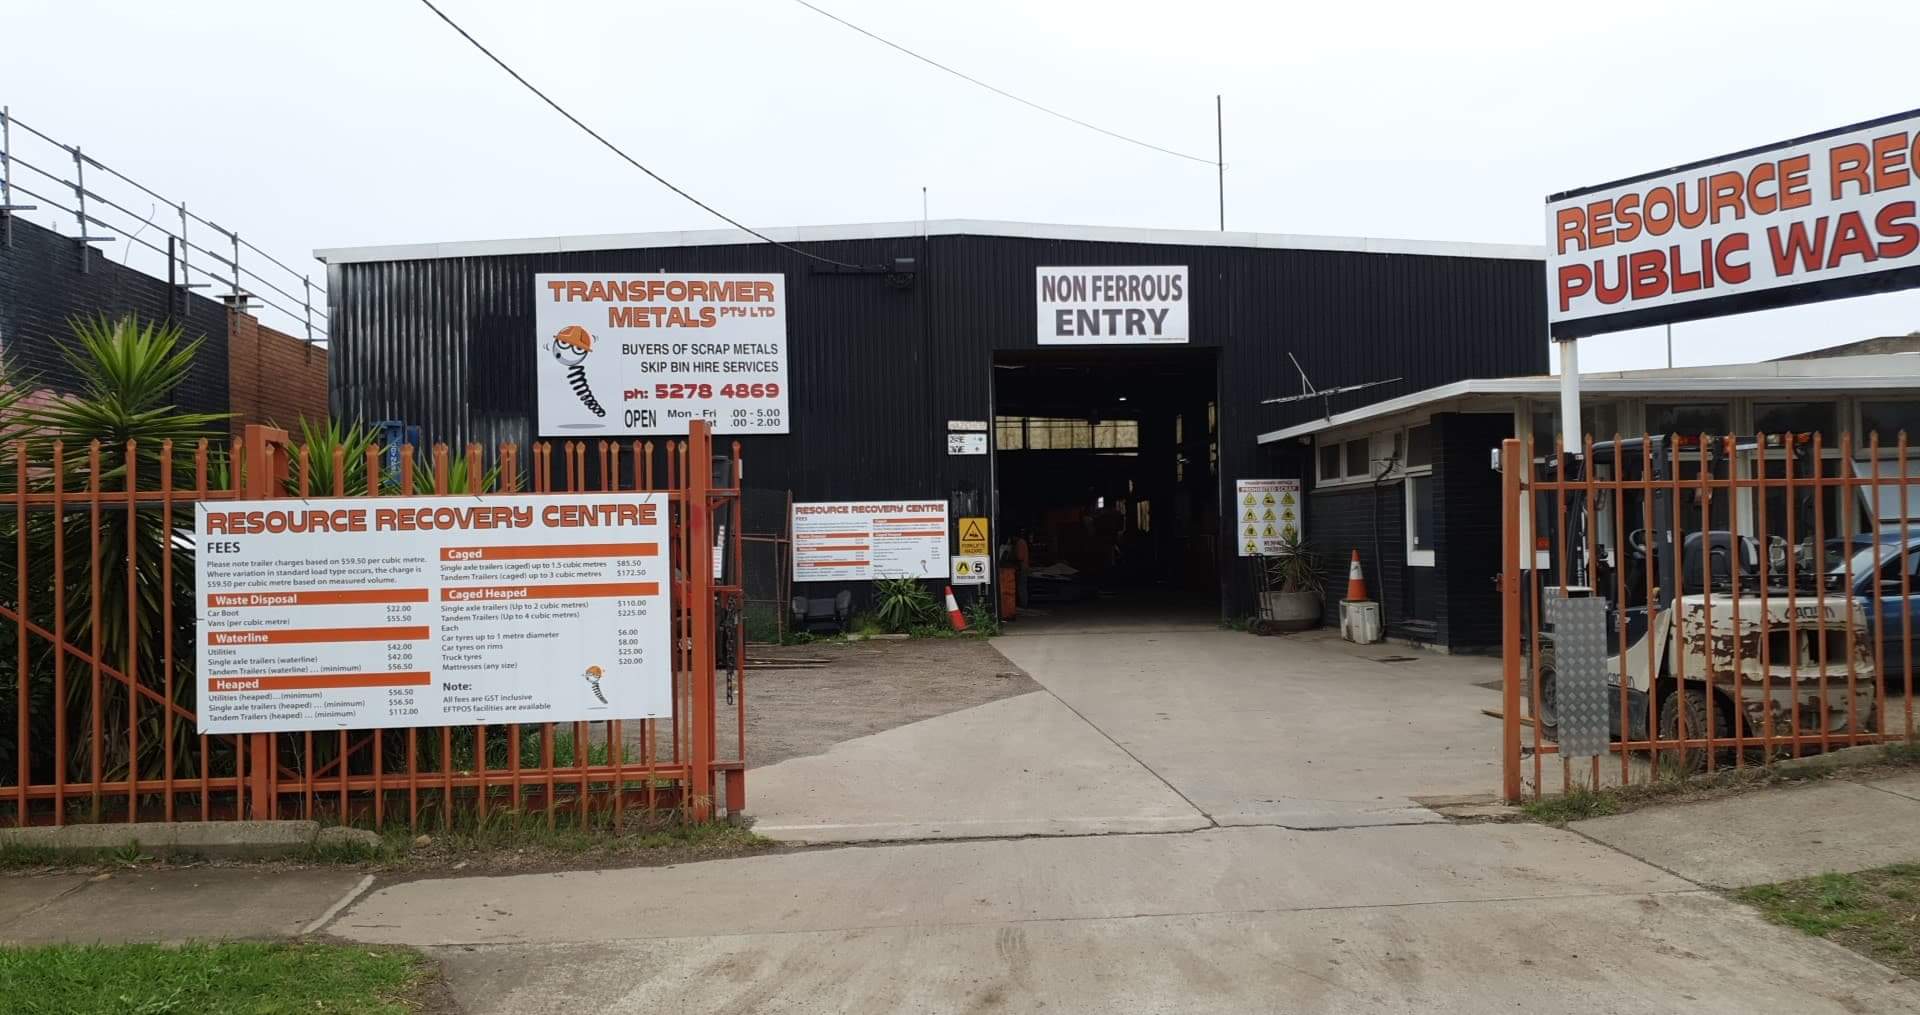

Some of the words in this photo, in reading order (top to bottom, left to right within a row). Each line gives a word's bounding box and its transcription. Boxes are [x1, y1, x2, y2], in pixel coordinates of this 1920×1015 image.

[1556, 154, 1812, 254] RESOURCE
[1830, 129, 1920, 200] RE
[1558, 232, 1750, 312] PUBLIC
[1767, 201, 1920, 276] WAS
[548, 280, 774, 302] TRANSFORMER
[1042, 275, 1086, 302] NON
[1092, 274, 1183, 302] FERROUS
[608, 306, 716, 328] METALS
[720, 307, 746, 318] PTY
[750, 307, 776, 318] LTD
[1056, 308, 1169, 336] ENTRY
[622, 344, 670, 355] BUYERS
[672, 344, 688, 355] OF
[691, 344, 730, 355] SCRAP
[733, 344, 778, 354] METALS
[641, 362, 667, 373] SKIP
[671, 362, 690, 373] BIN
[693, 362, 721, 373] HIRE
[724, 362, 778, 372] SERVICES
[624, 388, 648, 400] ph:
[656, 384, 712, 399] 5278
[720, 384, 780, 398] 4869
[625, 410, 656, 428] OPEN
[668, 410, 692, 418] Mon
[703, 409, 716, 418] Fri
[757, 409, 780, 417] 5.00
[757, 418, 780, 427] 2.00
[796, 506, 848, 514] RESOURCE
[852, 504, 904, 514] RECOVERY
[906, 504, 944, 512] CENTRE
[207, 510, 367, 535] RESOURCE
[376, 506, 533, 531] RECOVERY
[542, 504, 656, 528] CENTRE
[208, 542, 240, 554] FEES
[448, 549, 482, 560] Caged
[274, 559, 304, 568] charges
[440, 564, 462, 572] Single
[505, 562, 530, 570] (caged)
[975, 563, 982, 572] 5
[389, 566, 414, 574] charge
[208, 580, 231, 588] $59.50
[449, 589, 483, 600] Caged
[486, 587, 527, 600] Heaped
[216, 596, 248, 606] Waste
[250, 593, 297, 606] Disposal
[442, 604, 464, 614] Single
[482, 603, 508, 611] trailers
[510, 602, 522, 611] (Up
[561, 601, 588, 609] metres)
[227, 620, 242, 628] (per
[216, 632, 268, 644] Waterline
[456, 634, 474, 642] tyres
[526, 631, 560, 640] diameter
[456, 644, 474, 652] tyres
[208, 658, 231, 667] Single
[464, 654, 482, 662] tyres
[484, 662, 499, 670] (any
[501, 661, 518, 669] size)
[217, 679, 259, 690] Heaped
[443, 682, 472, 691] Note:
[474, 704, 504, 712] facilities
[518, 702, 551, 710] available
[270, 712, 302, 720] (heaped)
[315, 710, 356, 718] (minimum)
[390, 708, 418, 716] $112.00
